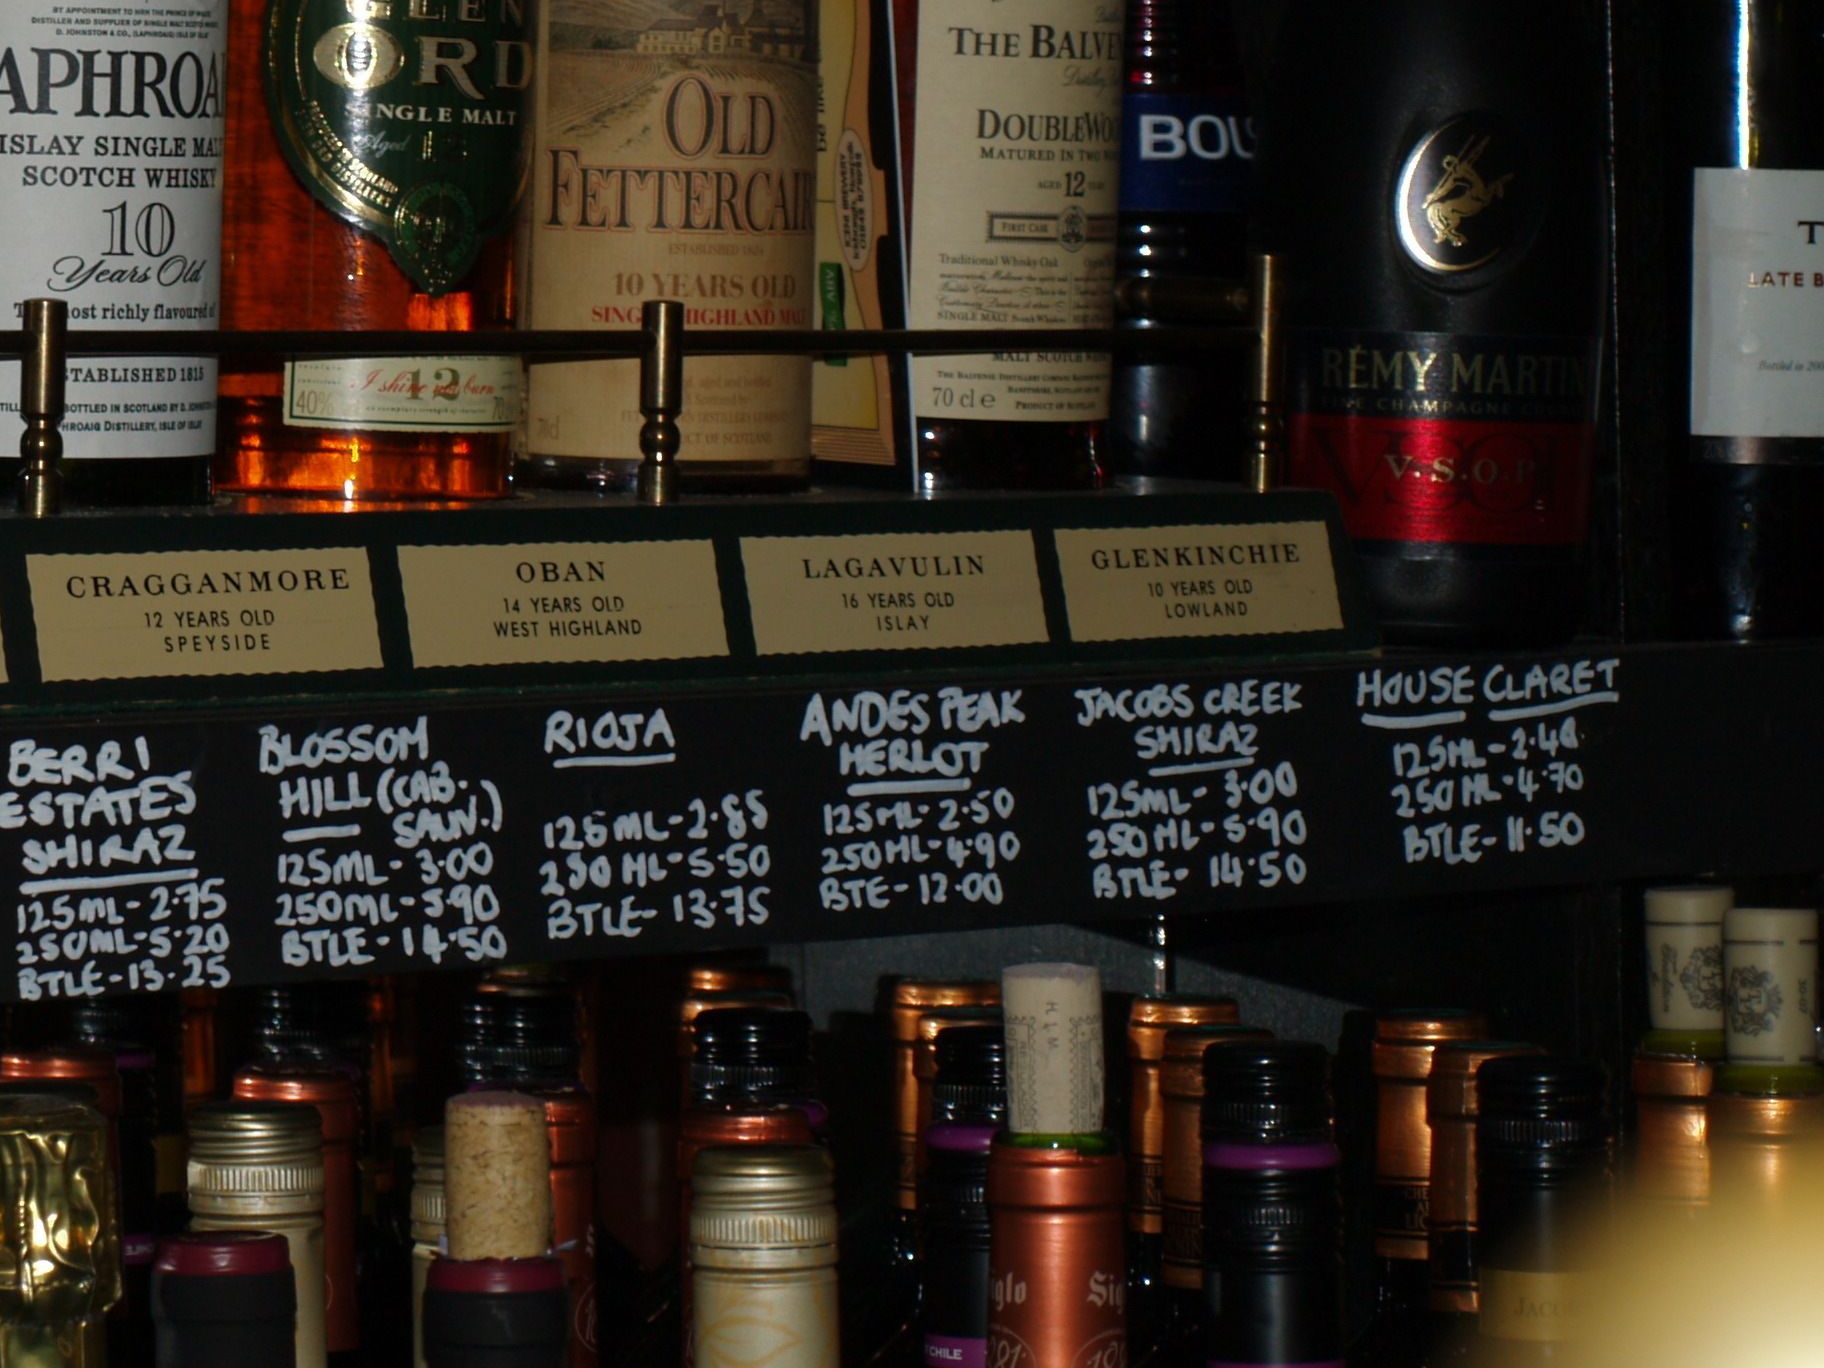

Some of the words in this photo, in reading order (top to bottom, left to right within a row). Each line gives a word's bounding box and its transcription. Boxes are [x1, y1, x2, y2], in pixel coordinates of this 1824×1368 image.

[948, 27, 1020, 57] THE
[665, 76, 776, 158] OLD
[94, 136, 186, 158] SINGLE
[980, 147, 1054, 161] MATURED
[1060, 148, 1074, 161] IN
[22, 166, 135, 188] SCOTCH
[144, 168, 217, 189] WHISKY
[1064, 171, 1086, 197] 12
[101, 201, 175, 258] 10
[46, 256, 152, 292] Years
[157, 255, 207, 287] Old
[1321, 344, 1438, 391] RÉMY
[803, 554, 985, 577] LAGAVULIN
[1091, 543, 1299, 569] GLENKINCHIE
[66, 569, 350, 597] CRAGGANMORE
[516, 561, 606, 584] OBAN
[841, 593, 859, 608] 16
[867, 592, 918, 608] YEARS
[925, 591, 954, 607] OLD
[1148, 582, 1163, 596] 10
[1170, 581, 1217, 596] YEARS
[1224, 579, 1253, 595] OLD
[503, 598, 521, 613] 14
[529, 596, 582, 613] YEARS
[592, 595, 625, 612] OLD
[1165, 601, 1247, 619] LOWLAND
[144, 611, 164, 628] 12
[175, 610, 235, 628] YEARS
[242, 609, 275, 626] OLD
[494, 621, 542, 638] WEST
[548, 619, 643, 637] HIGHLAND
[877, 614, 929, 630] ISLAY
[164, 634, 270, 652] SPEYSIDE
[1356, 665, 1475, 707] HOUSE
[1482, 658, 1620, 703] CLARET
[800, 690, 930, 746] ANDES
[939, 686, 1026, 731] PEAK
[1074, 683, 1194, 726] JACOBS
[1203, 679, 1302, 716] CREEK
[259, 715, 429, 774] BLOSSOM
[544, 708, 676, 755] RIOJA
[1134, 724, 1259, 760] SHIRAZ
[9, 736, 150, 787] BERRI
[839, 739, 989, 777] MERLOT
[279, 772, 372, 819] HILL
[22, 824, 195, 874] SHIRAZ
